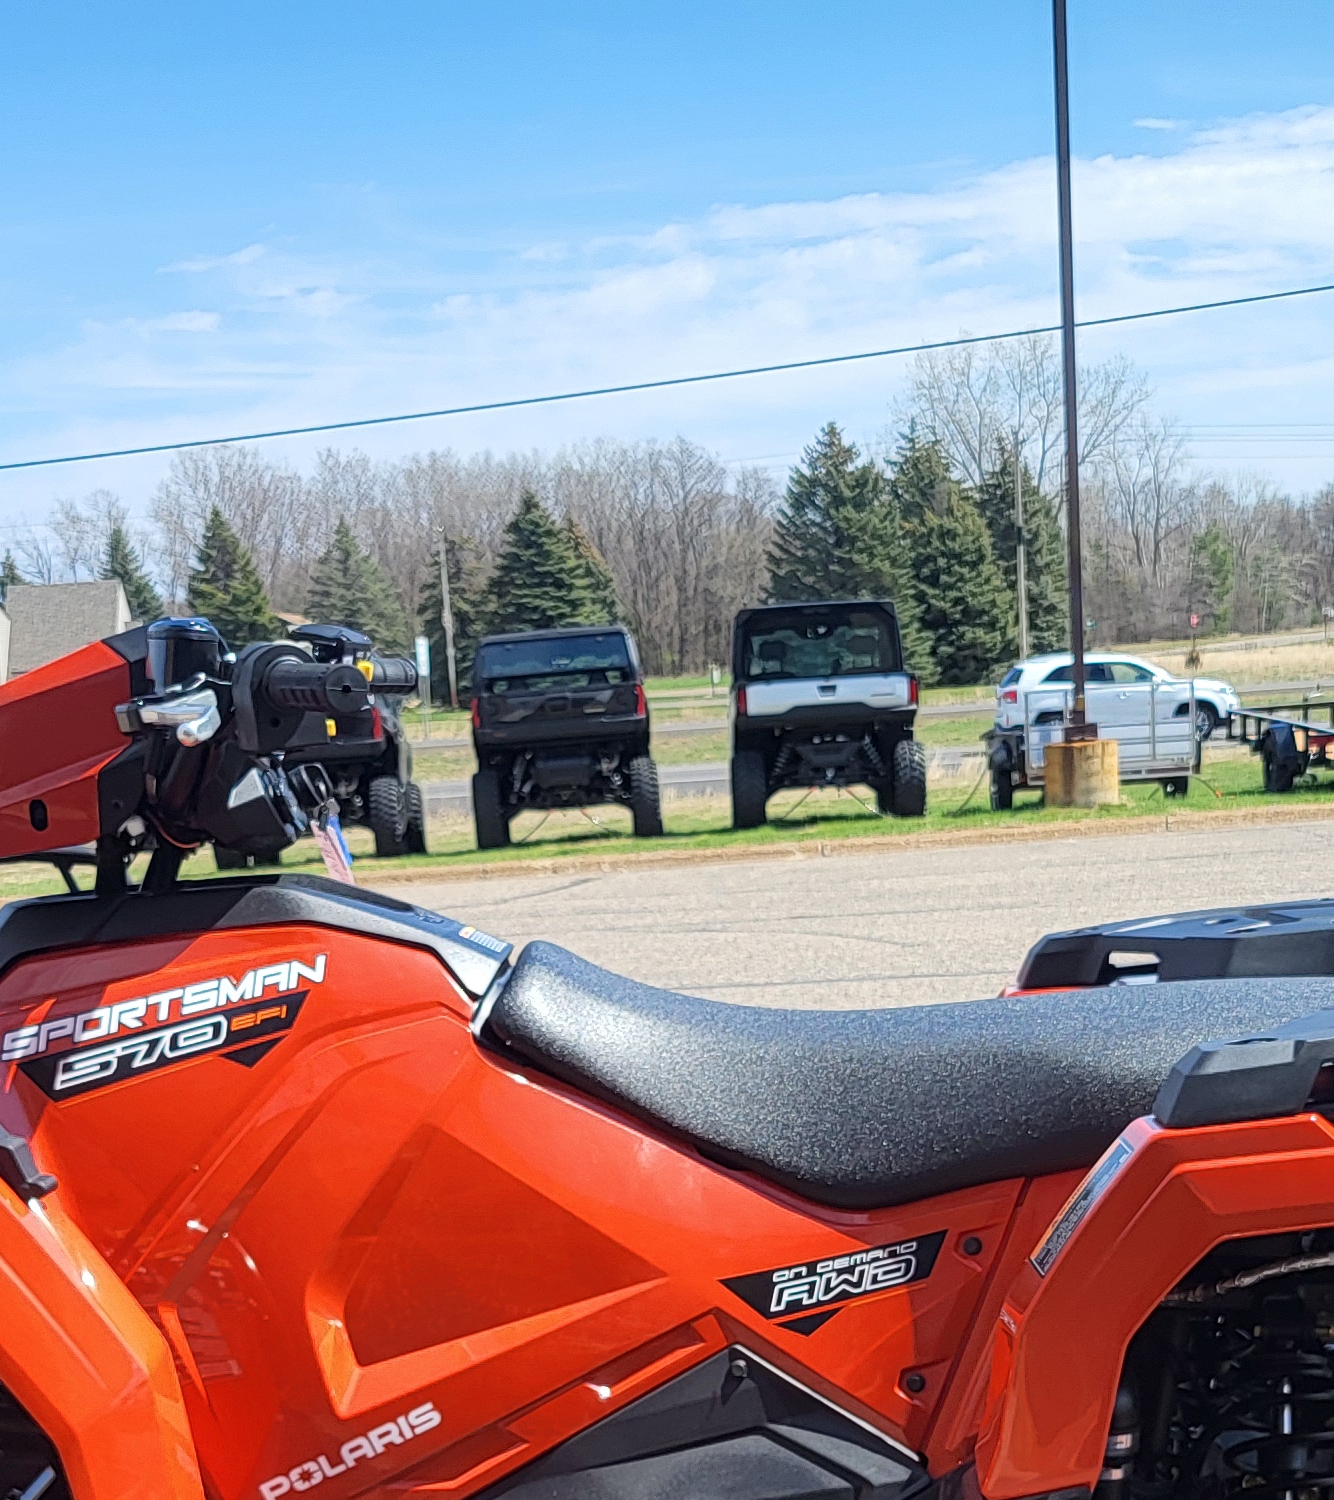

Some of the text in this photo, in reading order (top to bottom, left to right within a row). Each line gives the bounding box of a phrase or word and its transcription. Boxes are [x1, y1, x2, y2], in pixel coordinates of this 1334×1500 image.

[0, 953, 327, 1062] SPORTSMAN
[52, 1003, 288, 1091] 570 EFI
[769, 1254, 916, 1313] AWD
